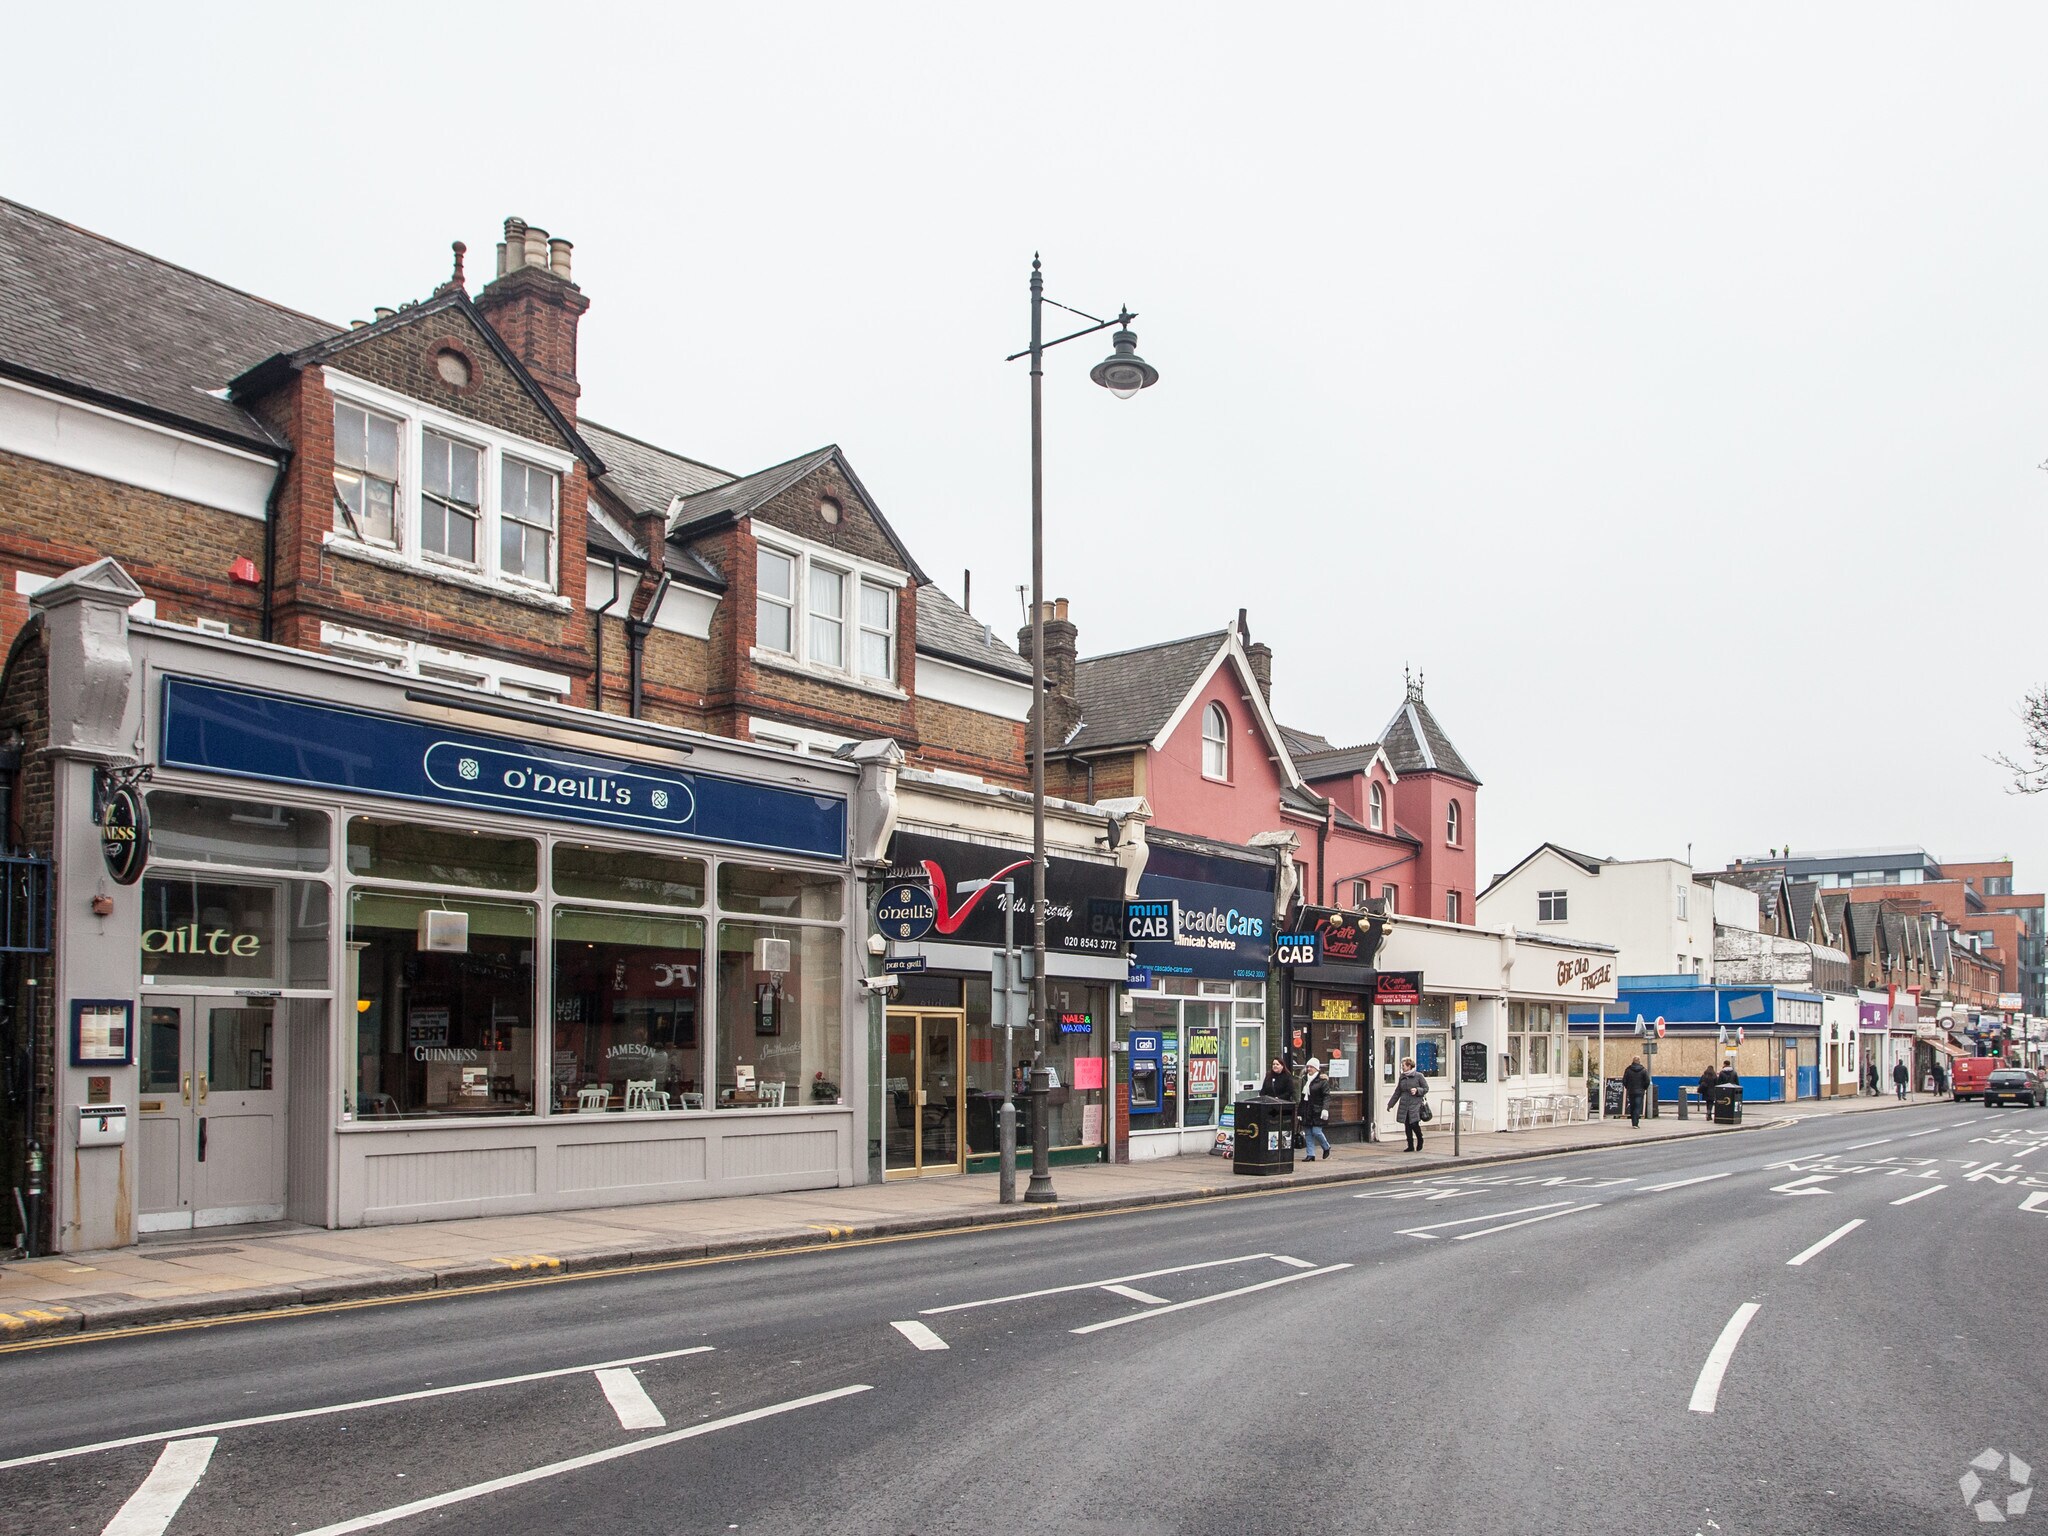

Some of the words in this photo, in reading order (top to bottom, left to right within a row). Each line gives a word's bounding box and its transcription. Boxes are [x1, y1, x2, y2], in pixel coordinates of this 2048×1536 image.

[997, 893, 1026, 913] Nils
[1128, 904, 1168, 917] mini
[1128, 917, 1169, 938] CAB
[1064, 936, 1079, 947] 020
[1080, 938, 1099, 949] 8543
[1100, 940, 1117, 950] 3772
[1208, 936, 1237, 951] Service
[1278, 934, 1315, 946] mini
[1278, 945, 1315, 964] CAB
[1060, 1022, 1092, 1034] WAXING
[605, 1043, 657, 1059] JAMESON
[1139, 1040, 1153, 1049] cash
[1189, 1035, 1218, 1055] AIRPORTS
[414, 1046, 478, 1062] GUINNESS
